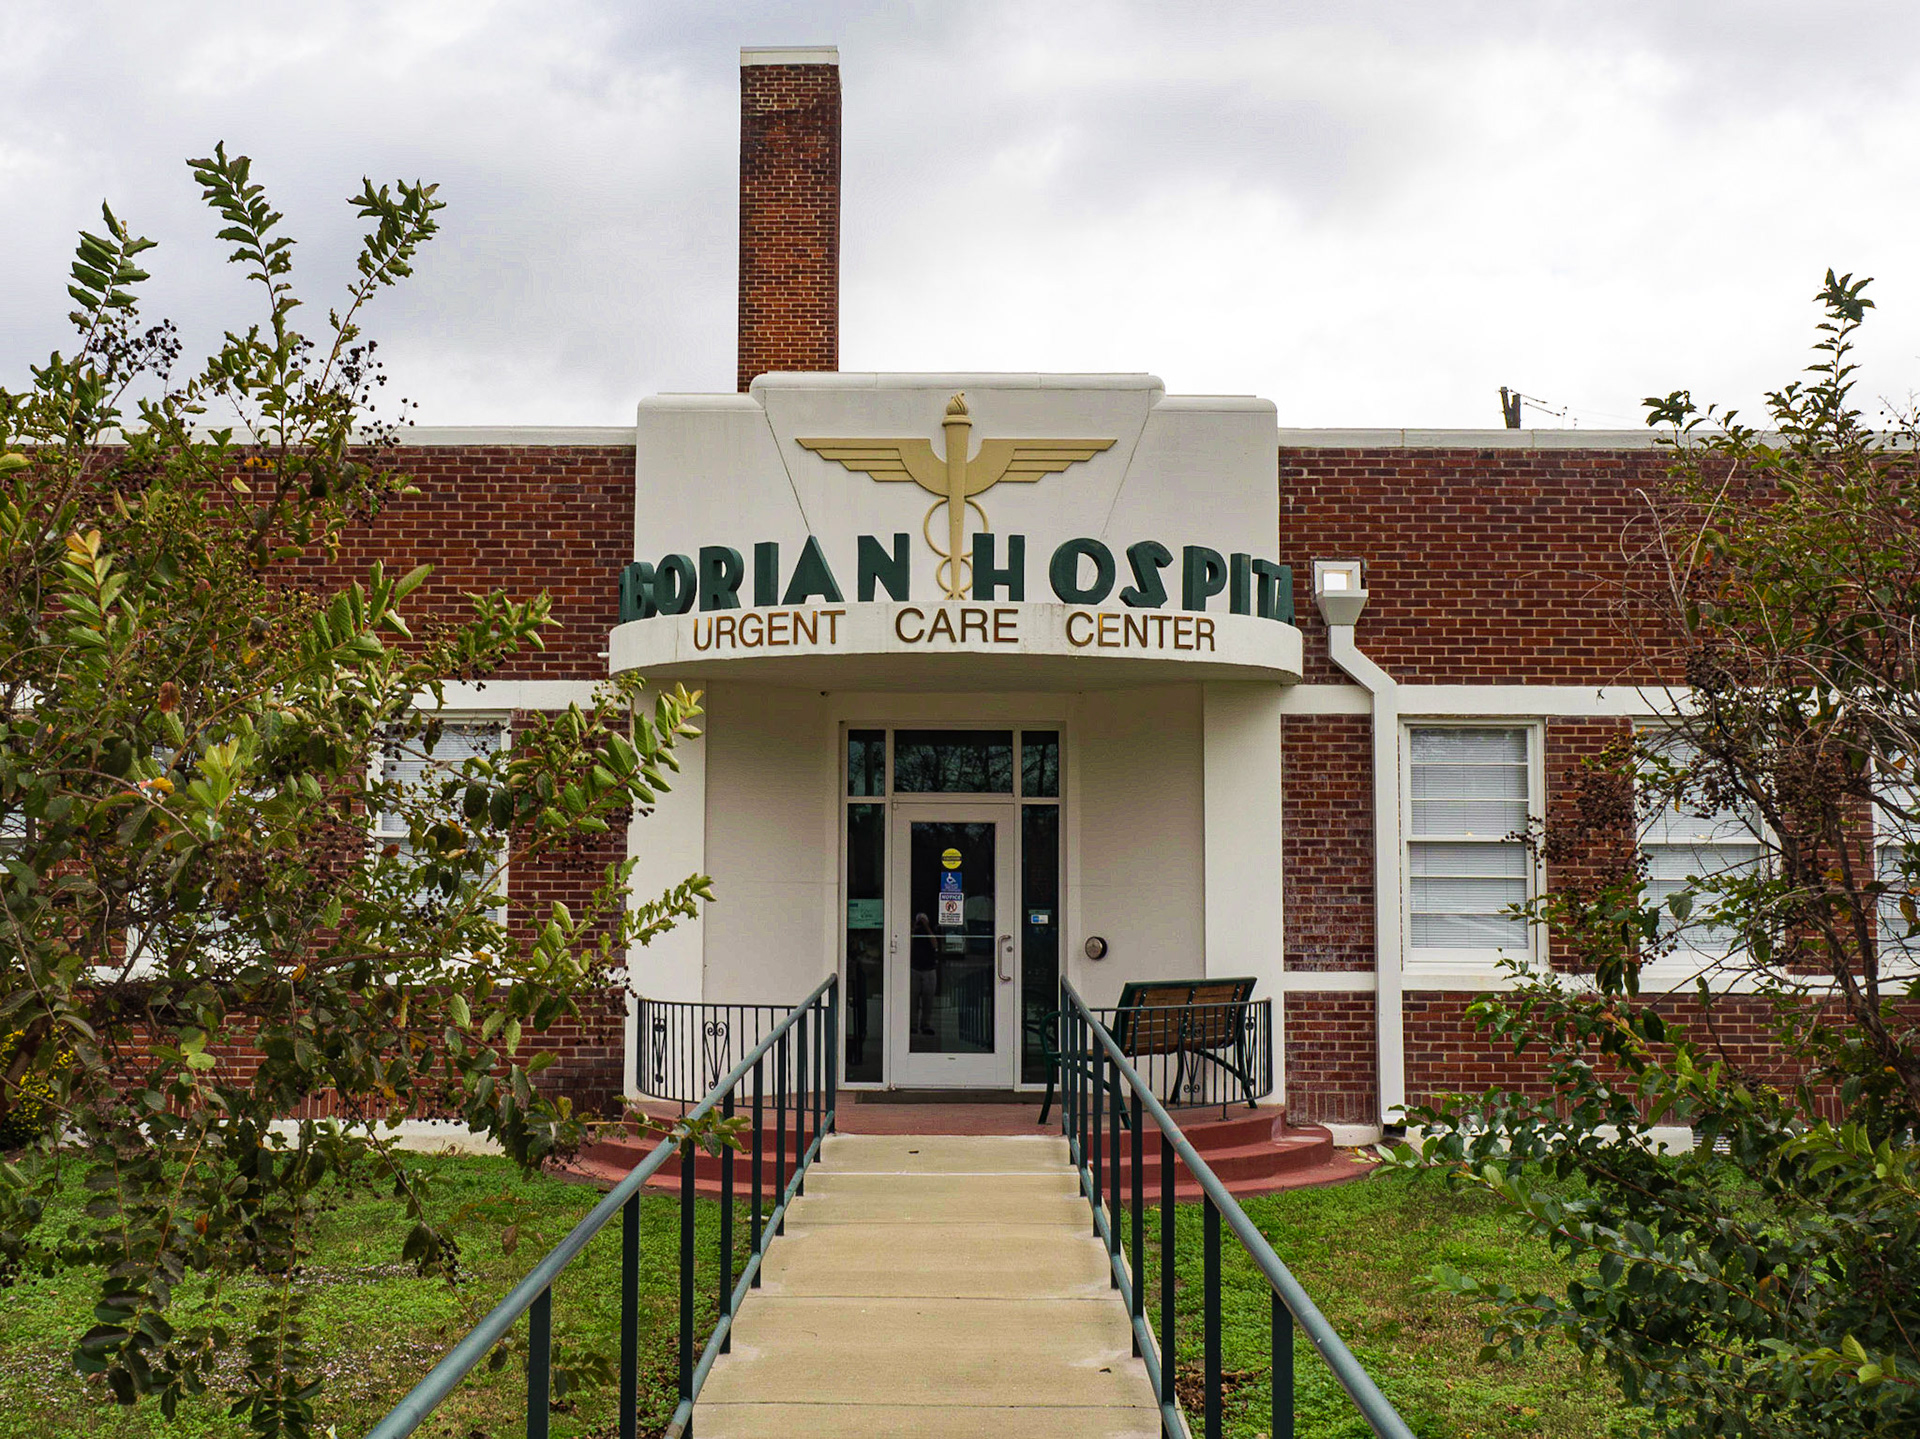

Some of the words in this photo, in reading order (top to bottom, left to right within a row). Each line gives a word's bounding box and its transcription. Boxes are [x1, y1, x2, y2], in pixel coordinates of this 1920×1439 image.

[693, 610, 846, 651] URGENT
[895, 607, 1019, 643] CARE
[1066, 611, 1216, 652] CENTER
